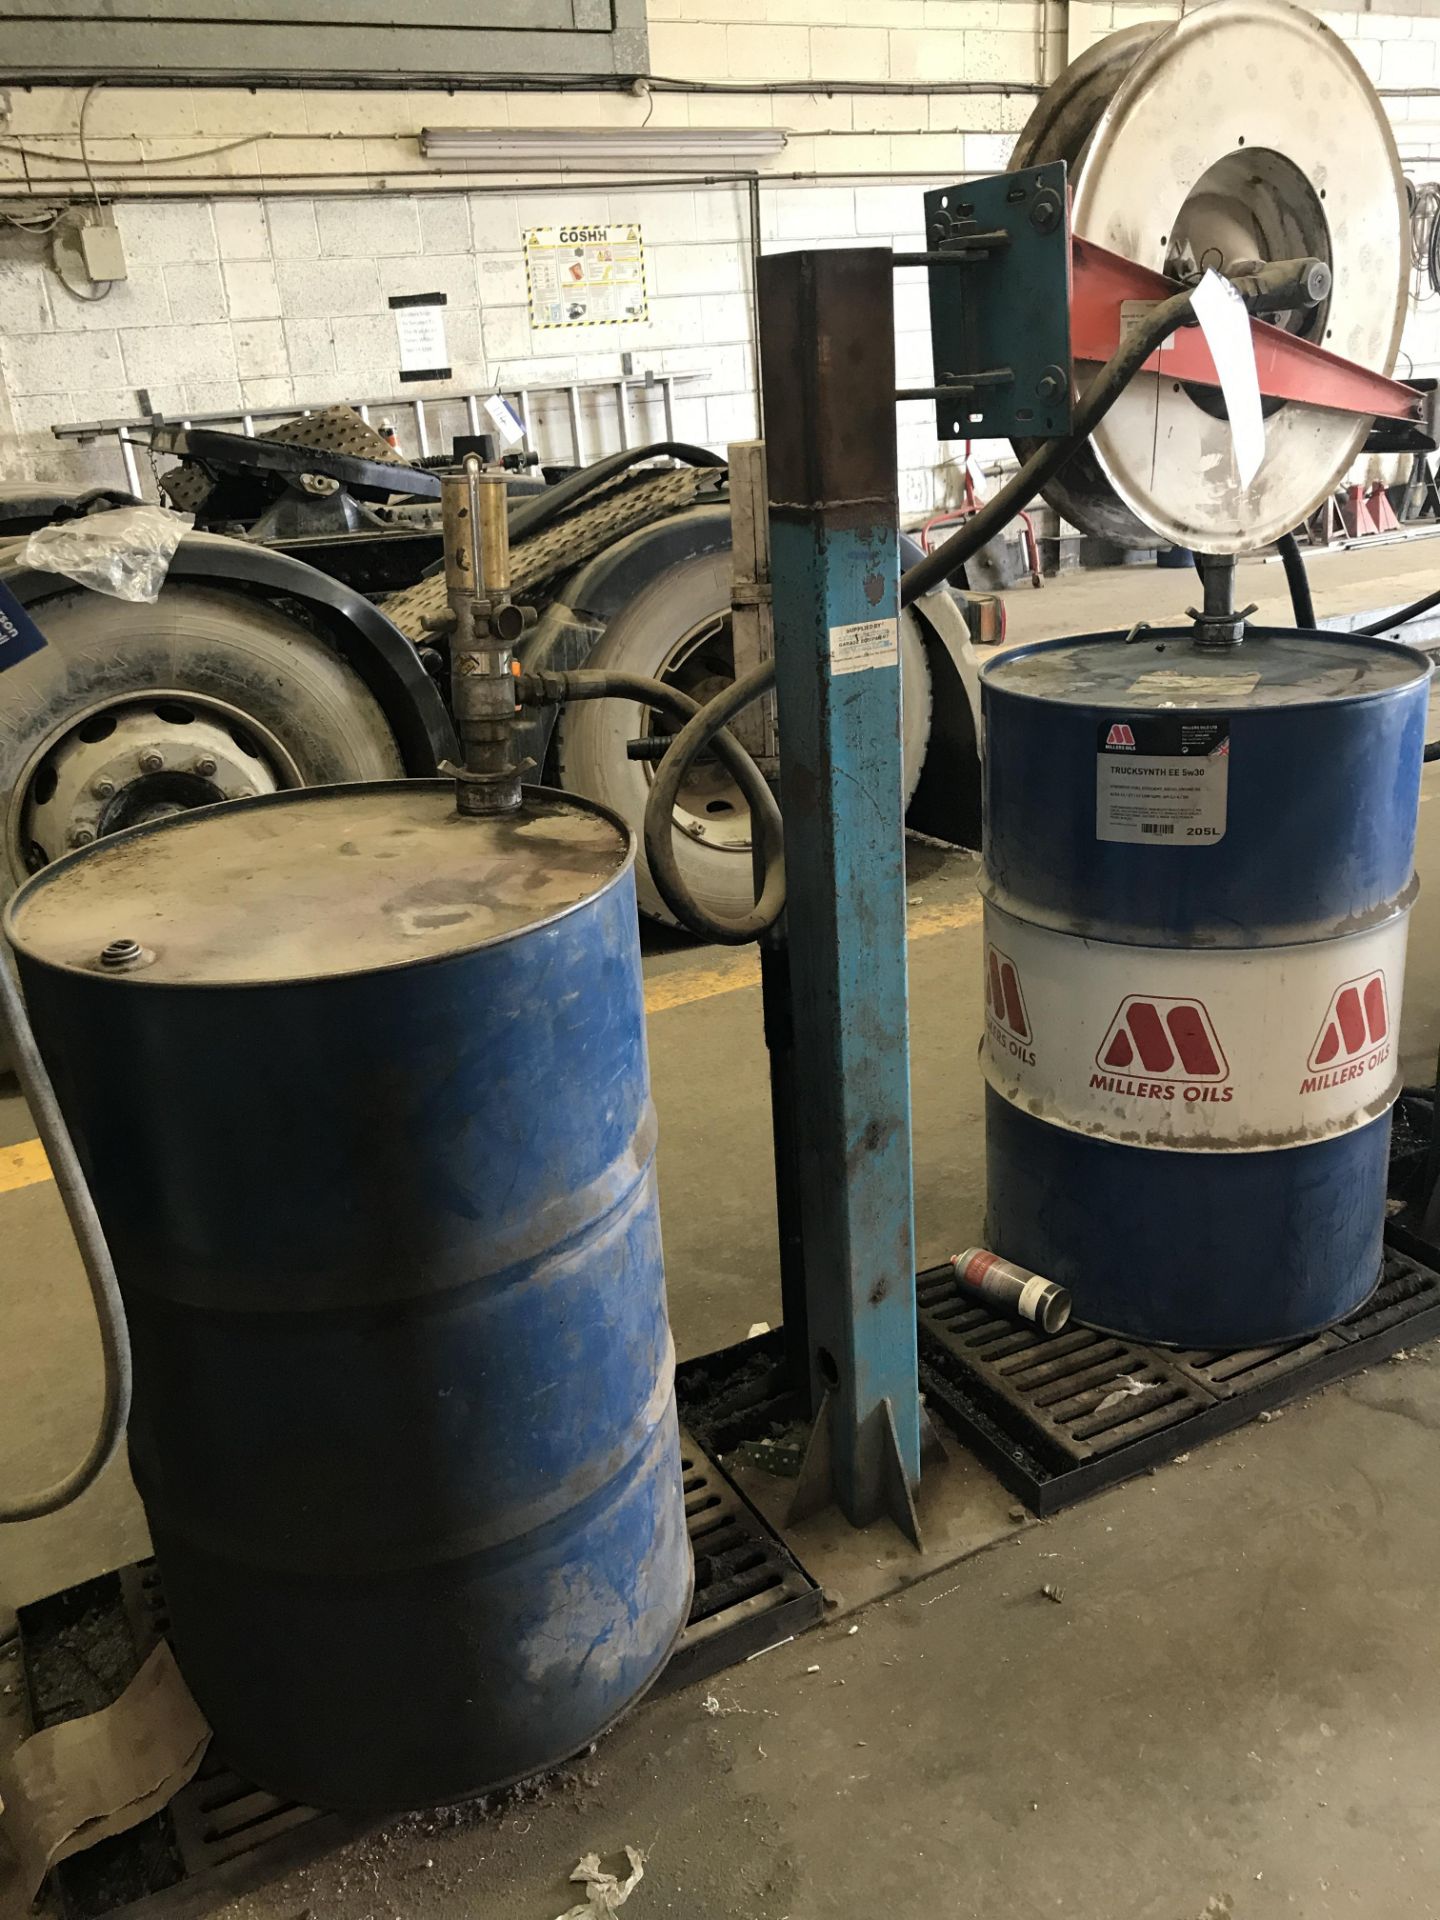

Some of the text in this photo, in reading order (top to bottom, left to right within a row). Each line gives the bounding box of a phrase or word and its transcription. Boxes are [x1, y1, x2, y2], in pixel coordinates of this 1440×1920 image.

[559, 230, 607, 243] COSHH
[1110, 766, 1167, 776] TRUCKSYNTH
[1182, 768, 1205, 777] 5w30
[1186, 827, 1220, 836] 205L
[1009, 1041, 1036, 1067] OILS
[1299, 1043, 1391, 1095] MILLERS OILS
[1089, 1073, 1234, 1102] MILLERS OILS
